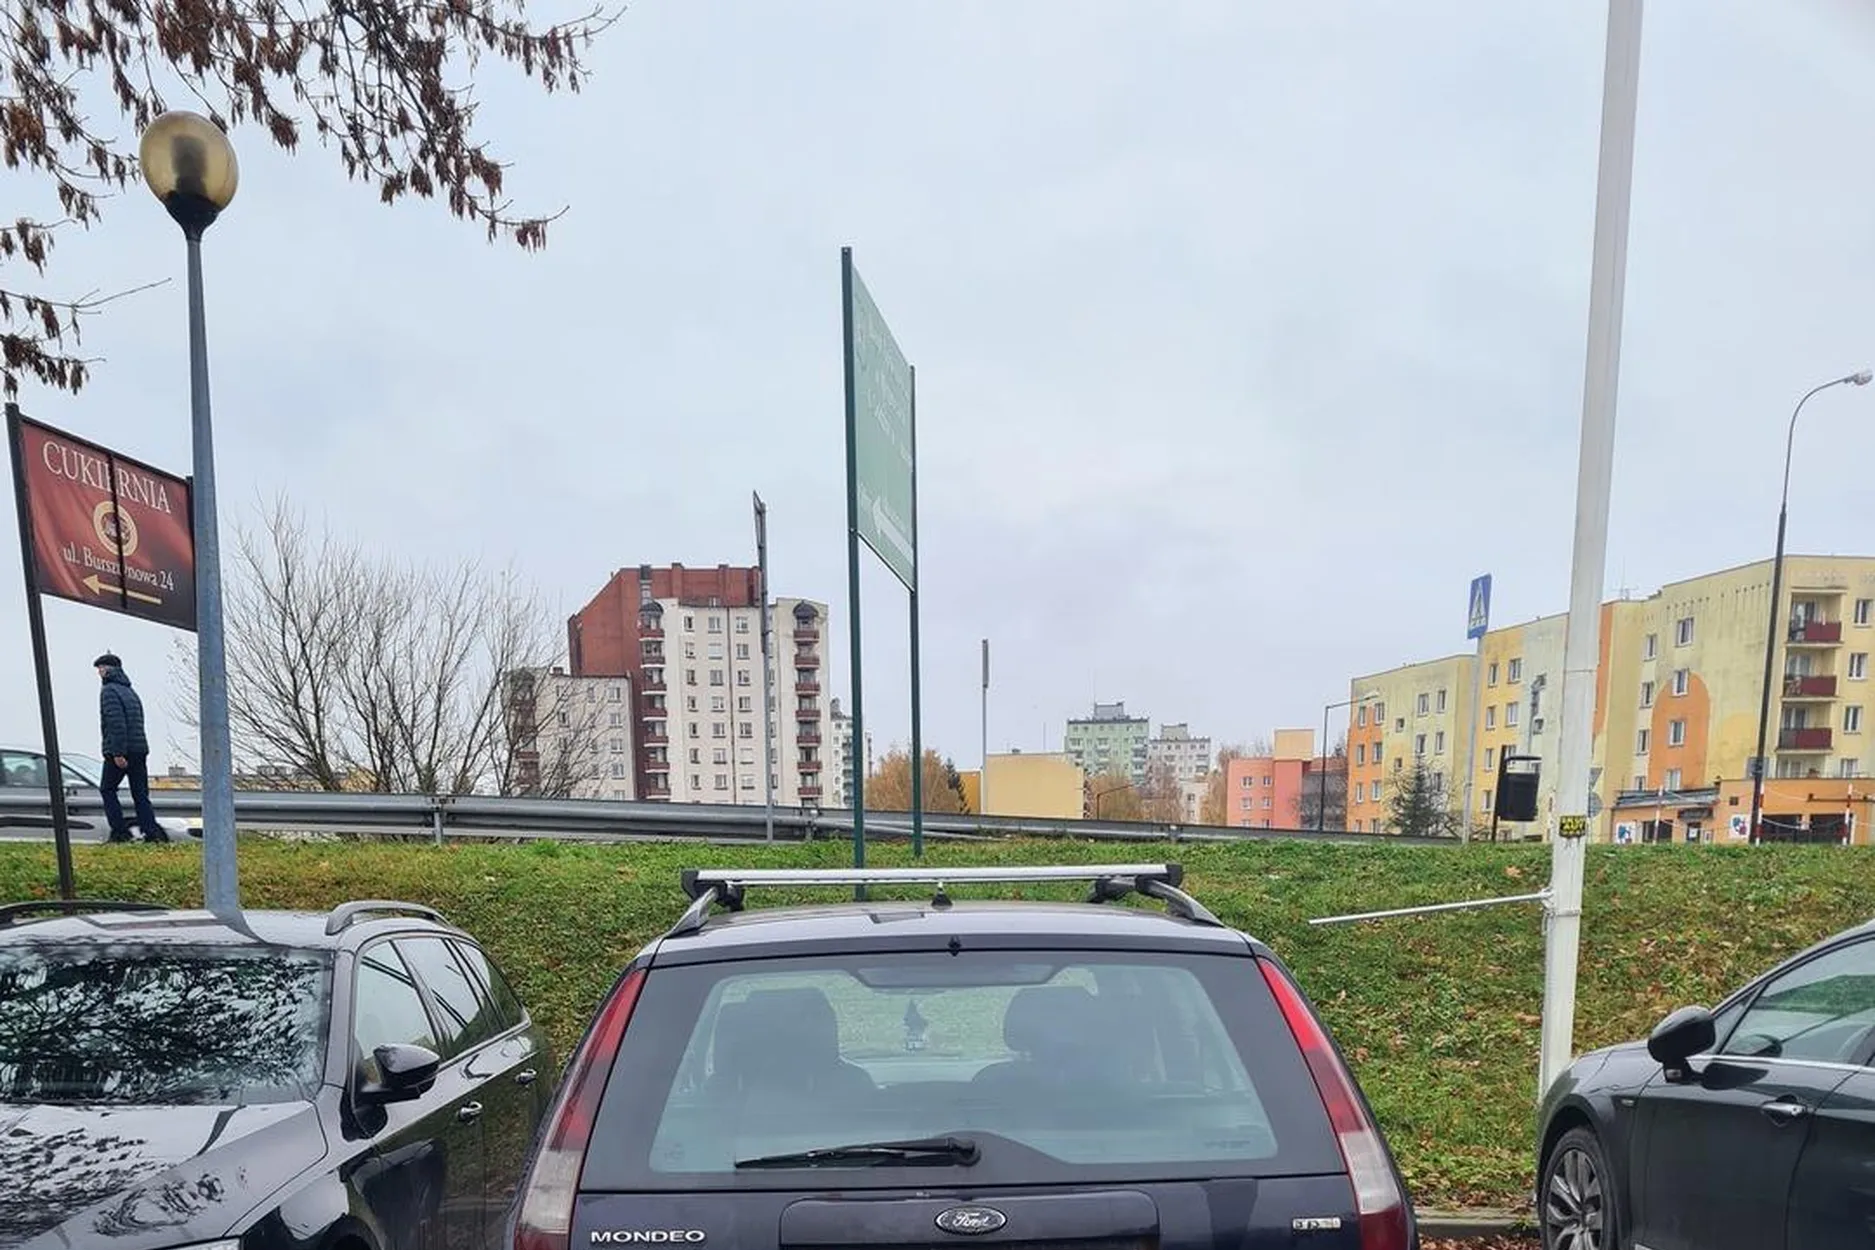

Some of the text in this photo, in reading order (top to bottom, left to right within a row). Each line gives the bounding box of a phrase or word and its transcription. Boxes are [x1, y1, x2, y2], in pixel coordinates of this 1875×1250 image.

[63, 542, 80, 564] ul.
[159, 570, 175, 591] 24
[952, 1210, 991, 1227] Ford
[590, 1230, 705, 1243] MONDEO
